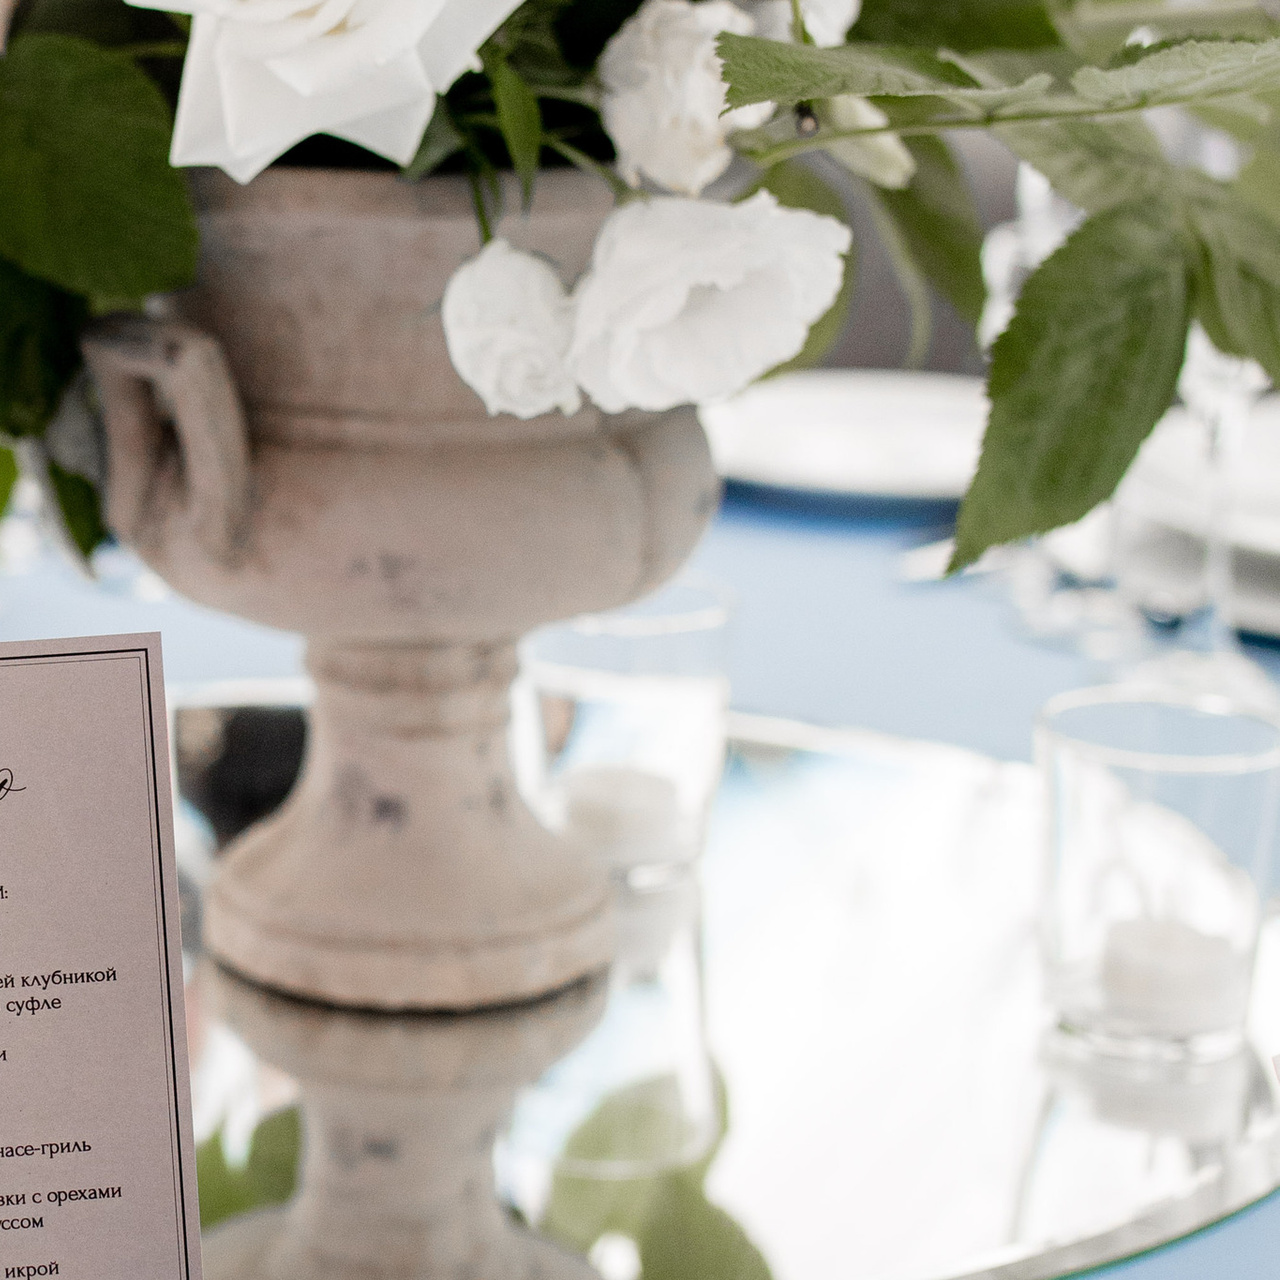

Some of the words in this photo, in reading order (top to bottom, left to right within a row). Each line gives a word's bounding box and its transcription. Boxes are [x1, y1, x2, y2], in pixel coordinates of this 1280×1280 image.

[20, 966, 118, 991] клубникой
[5, 996, 62, 1017] суфле
[31, 1192, 43, 1204] с
[46, 1186, 123, 1207] орехами
